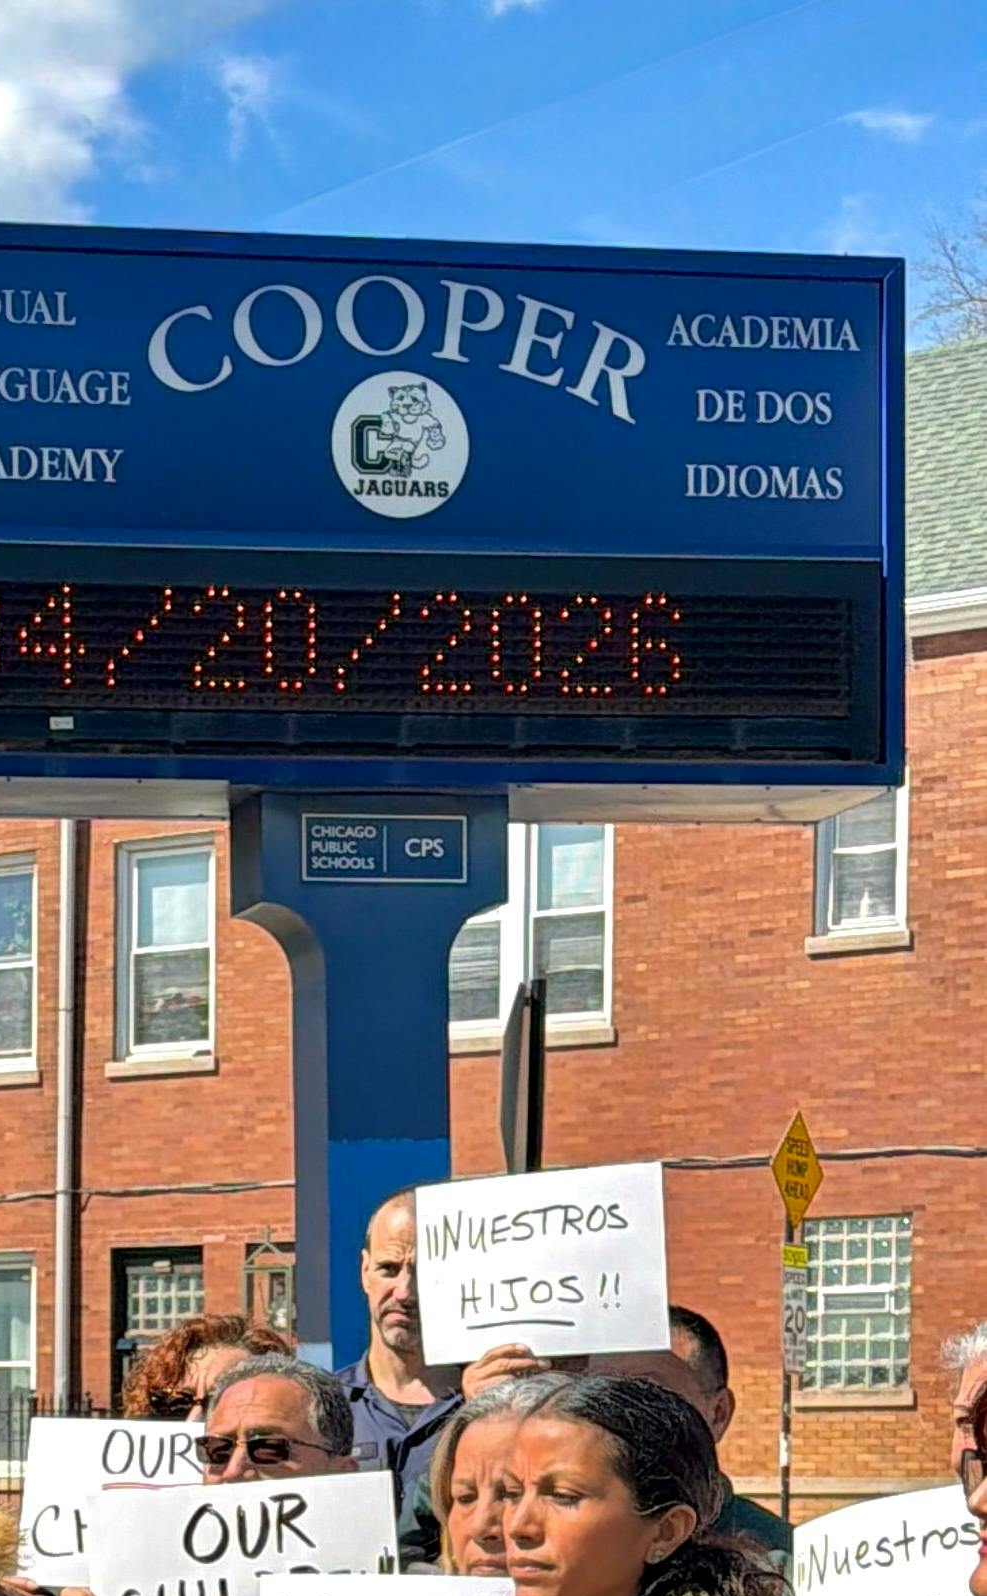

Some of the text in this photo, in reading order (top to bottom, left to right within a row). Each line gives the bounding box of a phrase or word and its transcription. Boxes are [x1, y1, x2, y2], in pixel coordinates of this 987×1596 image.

[666, 313, 860, 352] ACADEMIA
[148, 275, 646, 425] COOPER
[696, 389, 833, 426] DE DOS
[353, 479, 450, 497] JAGUARS
[685, 463, 843, 501] IDIOMAS
[311, 825, 377, 838] CHICAGO
[311, 840, 358, 854] PUBLIC
[404, 838, 444, 858] CPS
[311, 856, 376, 870] SCHOOLS
[786, 1138, 810, 1158] SPEED
[786, 1159, 809, 1178] HUMP
[784, 1180, 809, 1200] AHEAD
[784, 1271, 805, 1285] SPEED
[784, 1304, 805, 1334] 20
[102, 1429, 204, 1478] OUR
[183, 1493, 316, 1564] OUR
